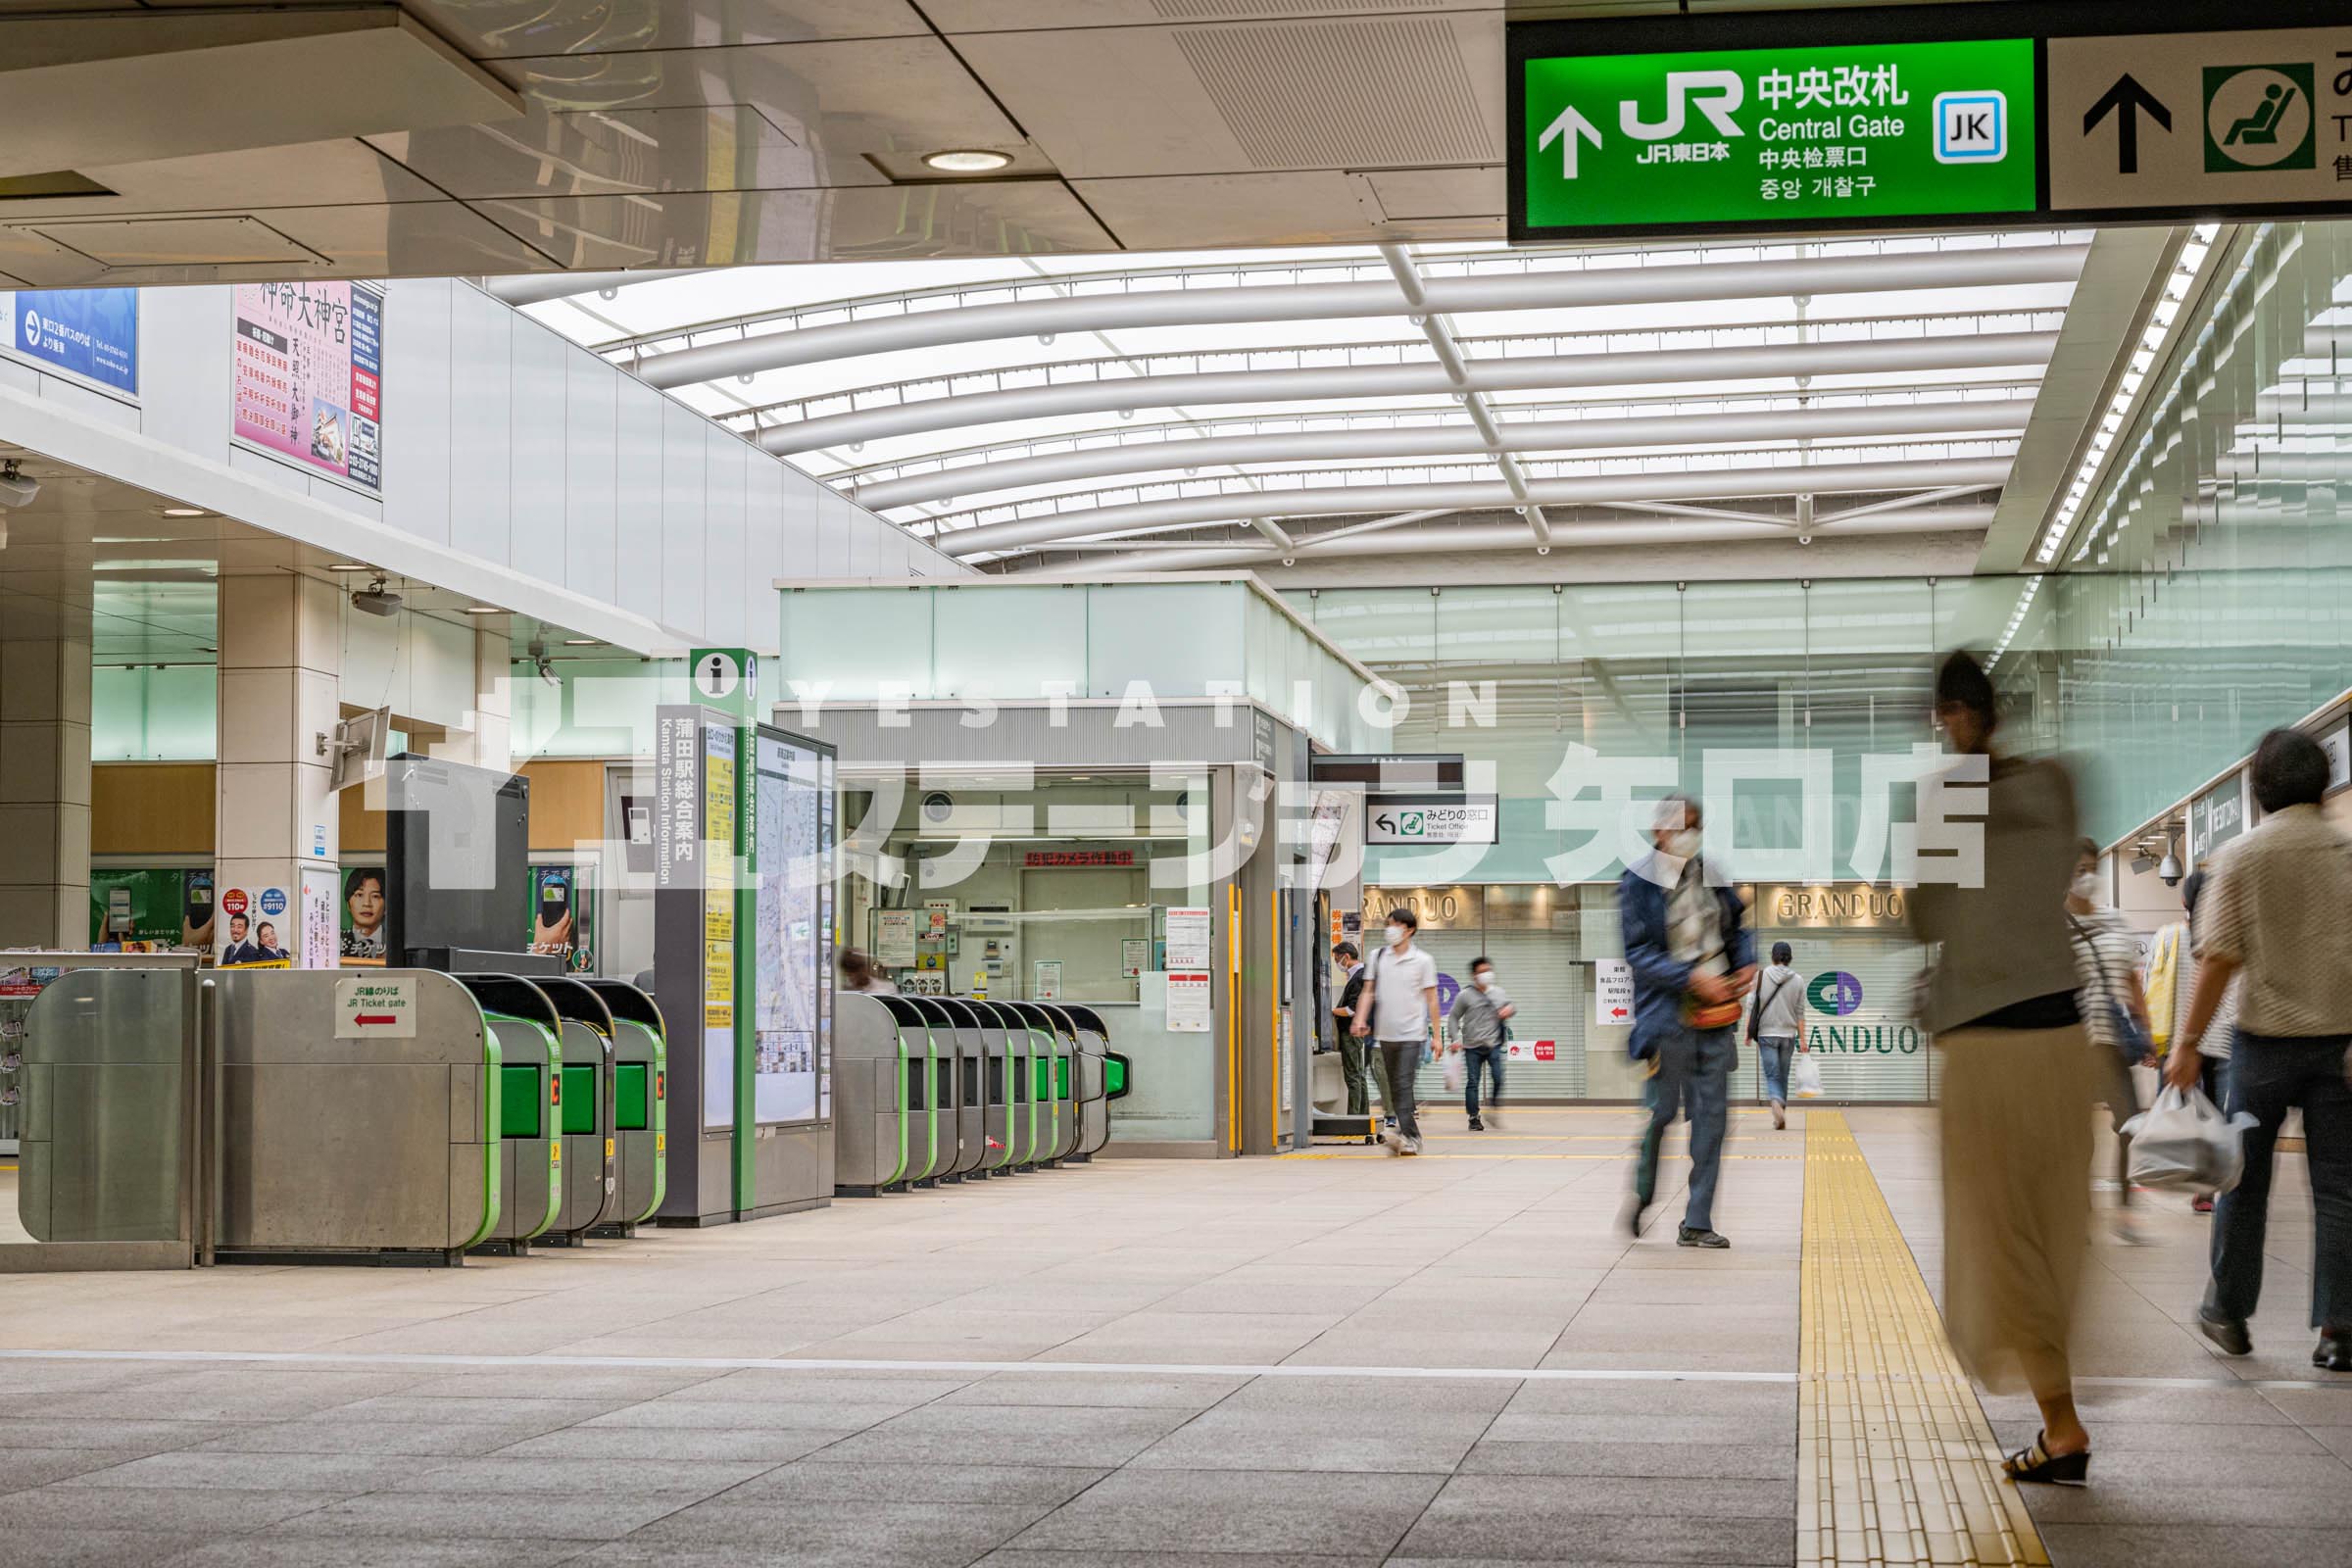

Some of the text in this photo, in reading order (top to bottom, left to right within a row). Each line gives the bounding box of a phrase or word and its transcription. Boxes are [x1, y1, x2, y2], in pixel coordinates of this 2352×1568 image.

[1758, 63, 1909, 111] 中央改札
[1619, 70, 1746, 141] JR
[1759, 115, 1905, 143] Central Gate
[1949, 113, 1990, 143] JK
[1636, 141, 1732, 166] JR東日本
[1759, 147, 1868, 172] 中央检票口
[1759, 175, 1877, 201] 중앙 개찰구
[661, 718, 672, 885] Kamata Station Information
[674, 717, 695, 861] 蒲田駅総合案内
[1427, 809, 1489, 821] みどりの窓口
[1777, 892, 1903, 919] GRANDUO
[347, 998, 407, 1009] JR Ticket gate
[354, 986, 400, 997] JR線のりば
